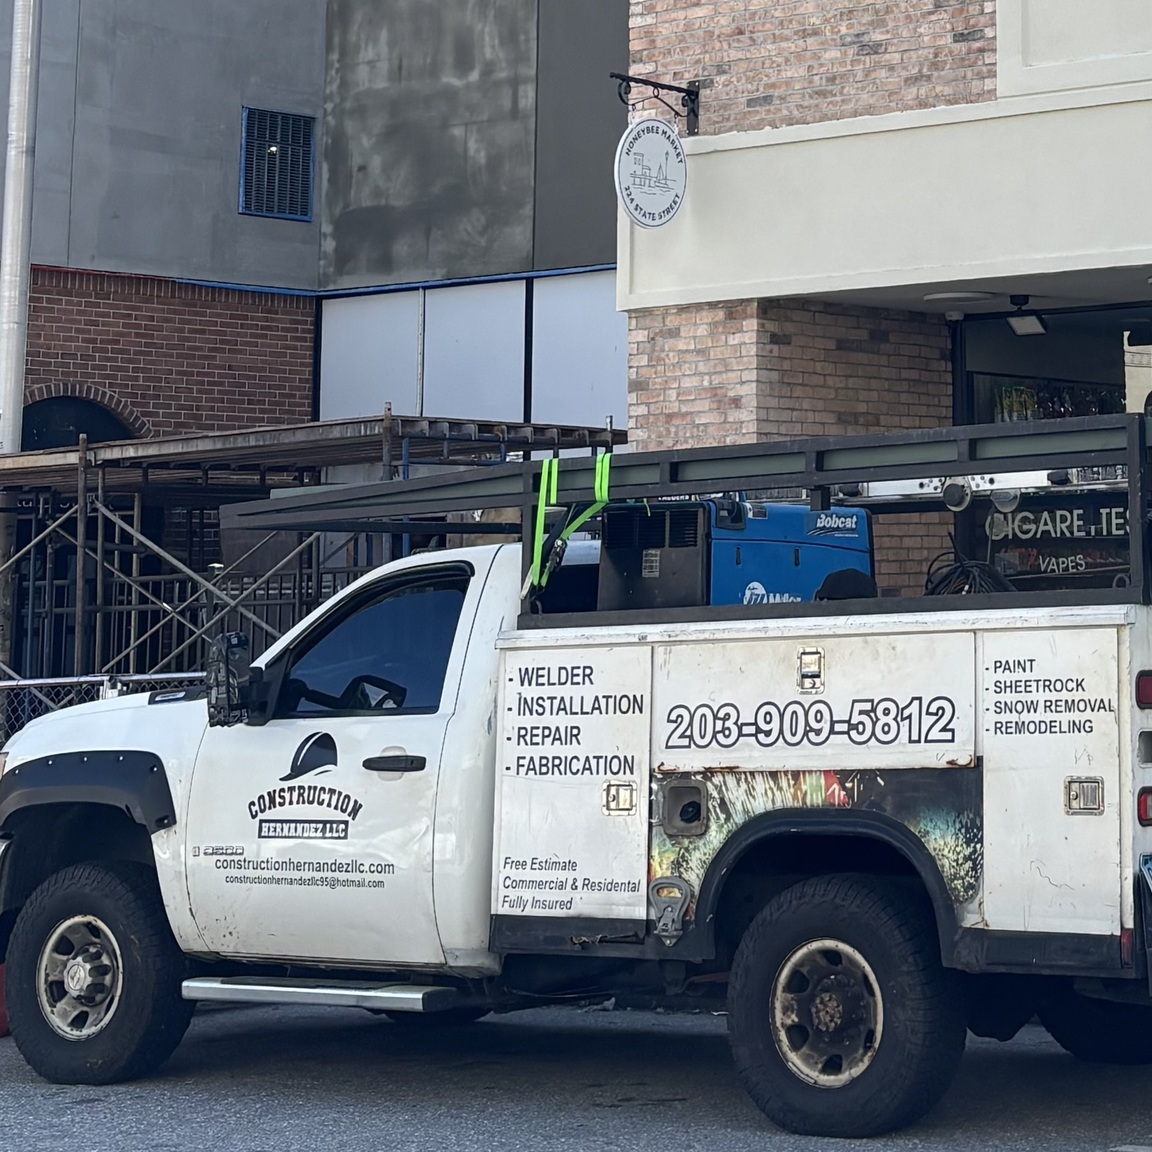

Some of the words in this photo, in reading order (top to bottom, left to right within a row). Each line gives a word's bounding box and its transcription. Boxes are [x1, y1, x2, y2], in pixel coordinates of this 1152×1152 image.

[625, 126, 660, 156] HONEYBEE
[661, 129, 683, 164] MARKET
[624, 185, 635, 204] 224
[634, 204, 656, 221] STATE
[658, 193, 680, 221] STREET
[816, 513, 858, 529] Bobcat
[1038, 554, 1086, 574] VAPES
[993, 659, 1036, 674] PAINT
[518, 666, 594, 687] WELDER
[993, 678, 1086, 694] SHEETROCK
[517, 694, 644, 716] INSTALLATION
[993, 699, 1039, 715] SNOW
[1044, 698, 1115, 714] REMOVAL
[665, 696, 956, 749] 203-909-5812
[994, 719, 1094, 735] REMODELING
[517, 725, 581, 746] REPAIR
[516, 755, 635, 776] FABRICATION
[248, 784, 363, 821] CONSTRUCTION
[260, 822, 323, 838] HERNANDEZ
[324, 822, 346, 838] LLC
[215, 857, 395, 875] constructionhernandezllc.com
[503, 856, 527, 870] Free
[530, 857, 578, 872] Estimate
[225, 874, 385, 889] constructionhernandezllc95@hotmail.com
[503, 876, 568, 891] Commercial
[570, 878, 579, 891] &
[582, 878, 641, 893] Residental
[501, 895, 529, 912] Fully
[531, 897, 573, 911] Insured
